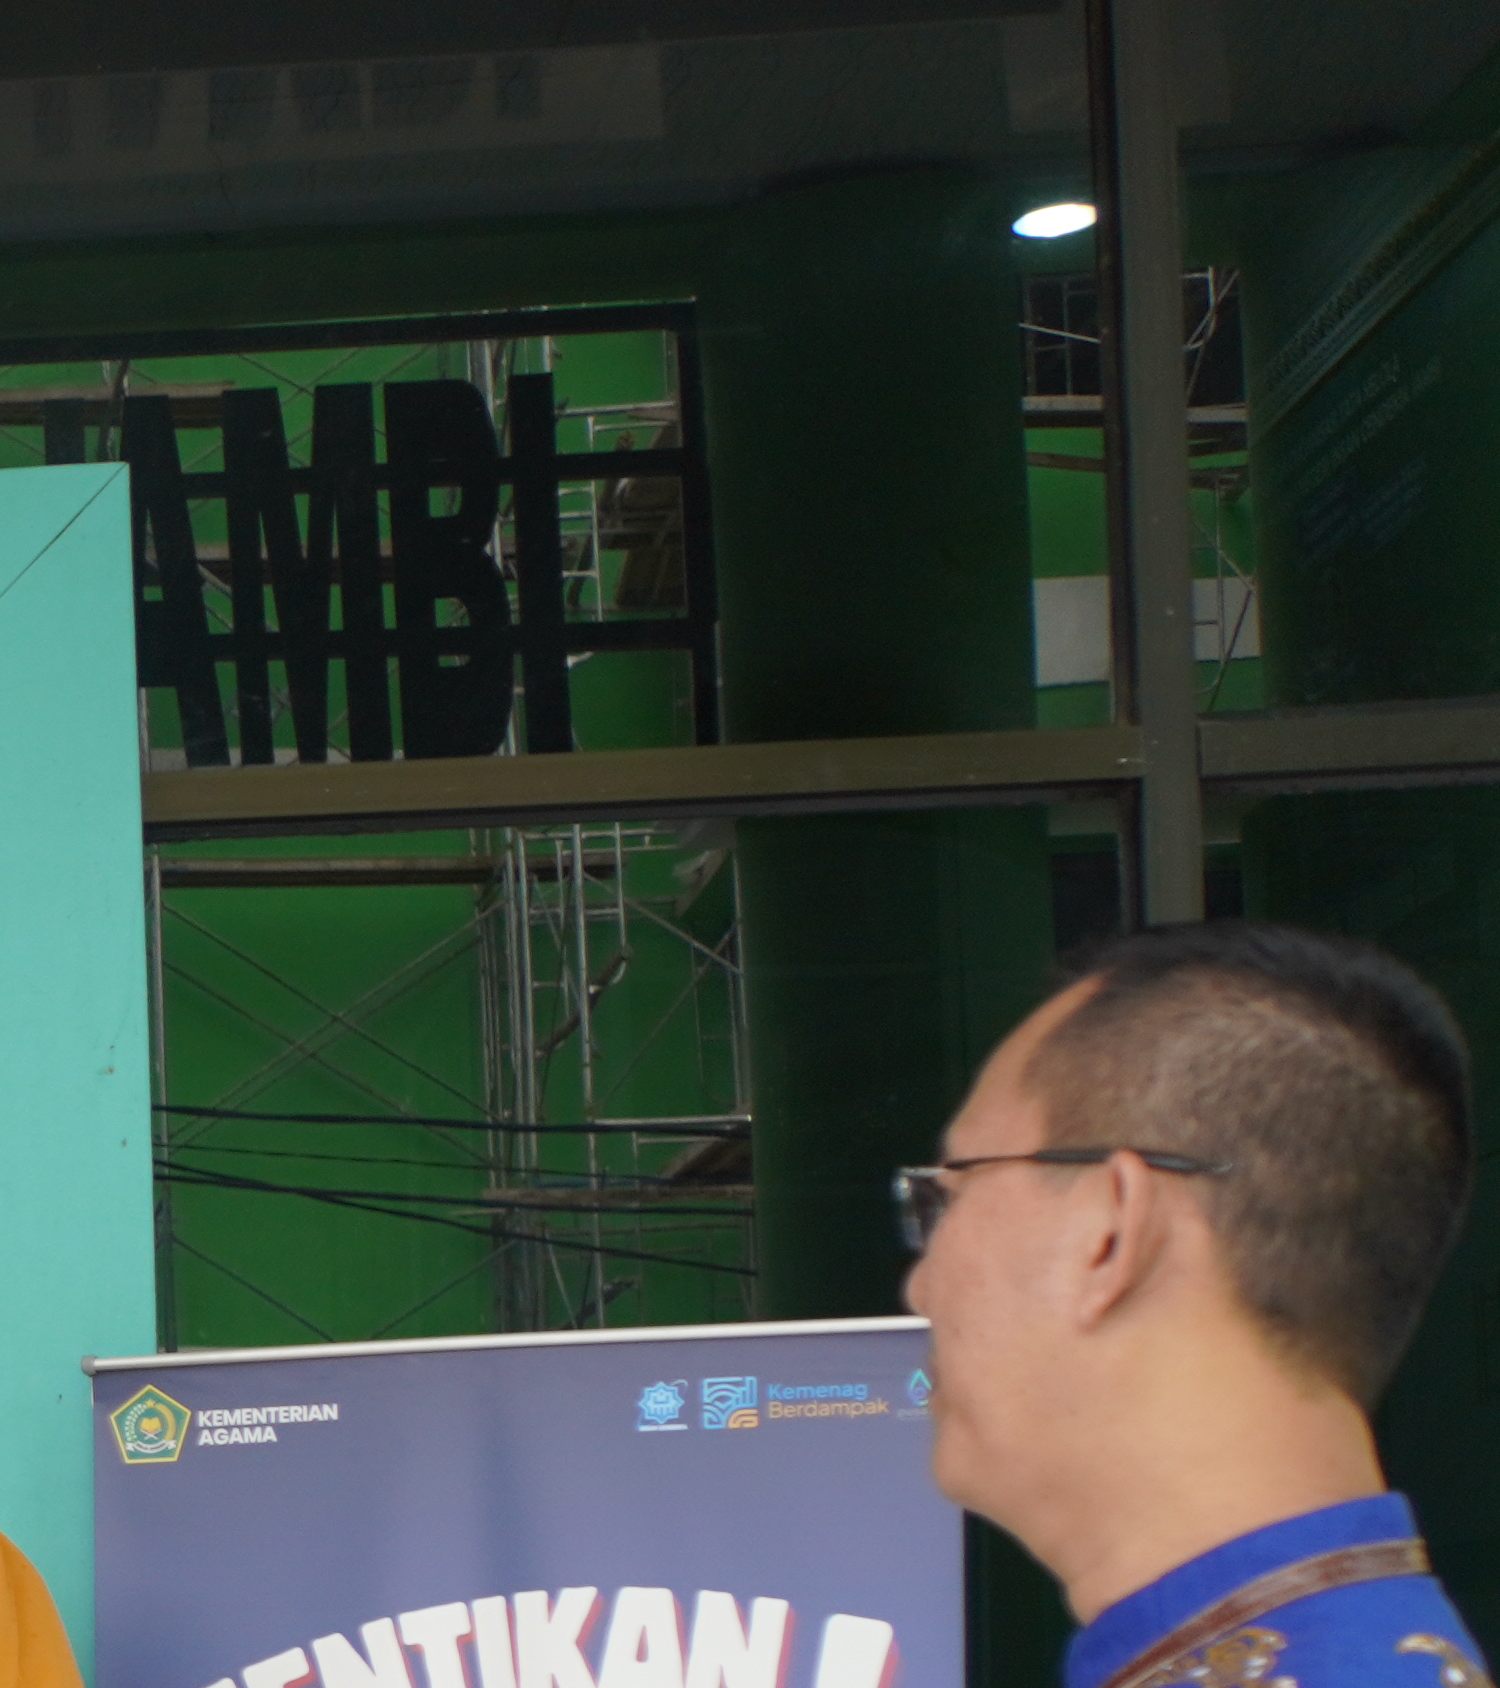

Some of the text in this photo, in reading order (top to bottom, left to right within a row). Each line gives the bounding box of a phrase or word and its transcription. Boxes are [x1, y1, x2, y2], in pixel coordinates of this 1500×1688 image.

[43, 374, 572, 768] AMBI
[765, 1384, 868, 1401] Kemenag
[198, 1403, 338, 1427] KEMENTERIAN
[767, 1397, 890, 1419] Berdampak
[198, 1426, 277, 1446] AGAMA
